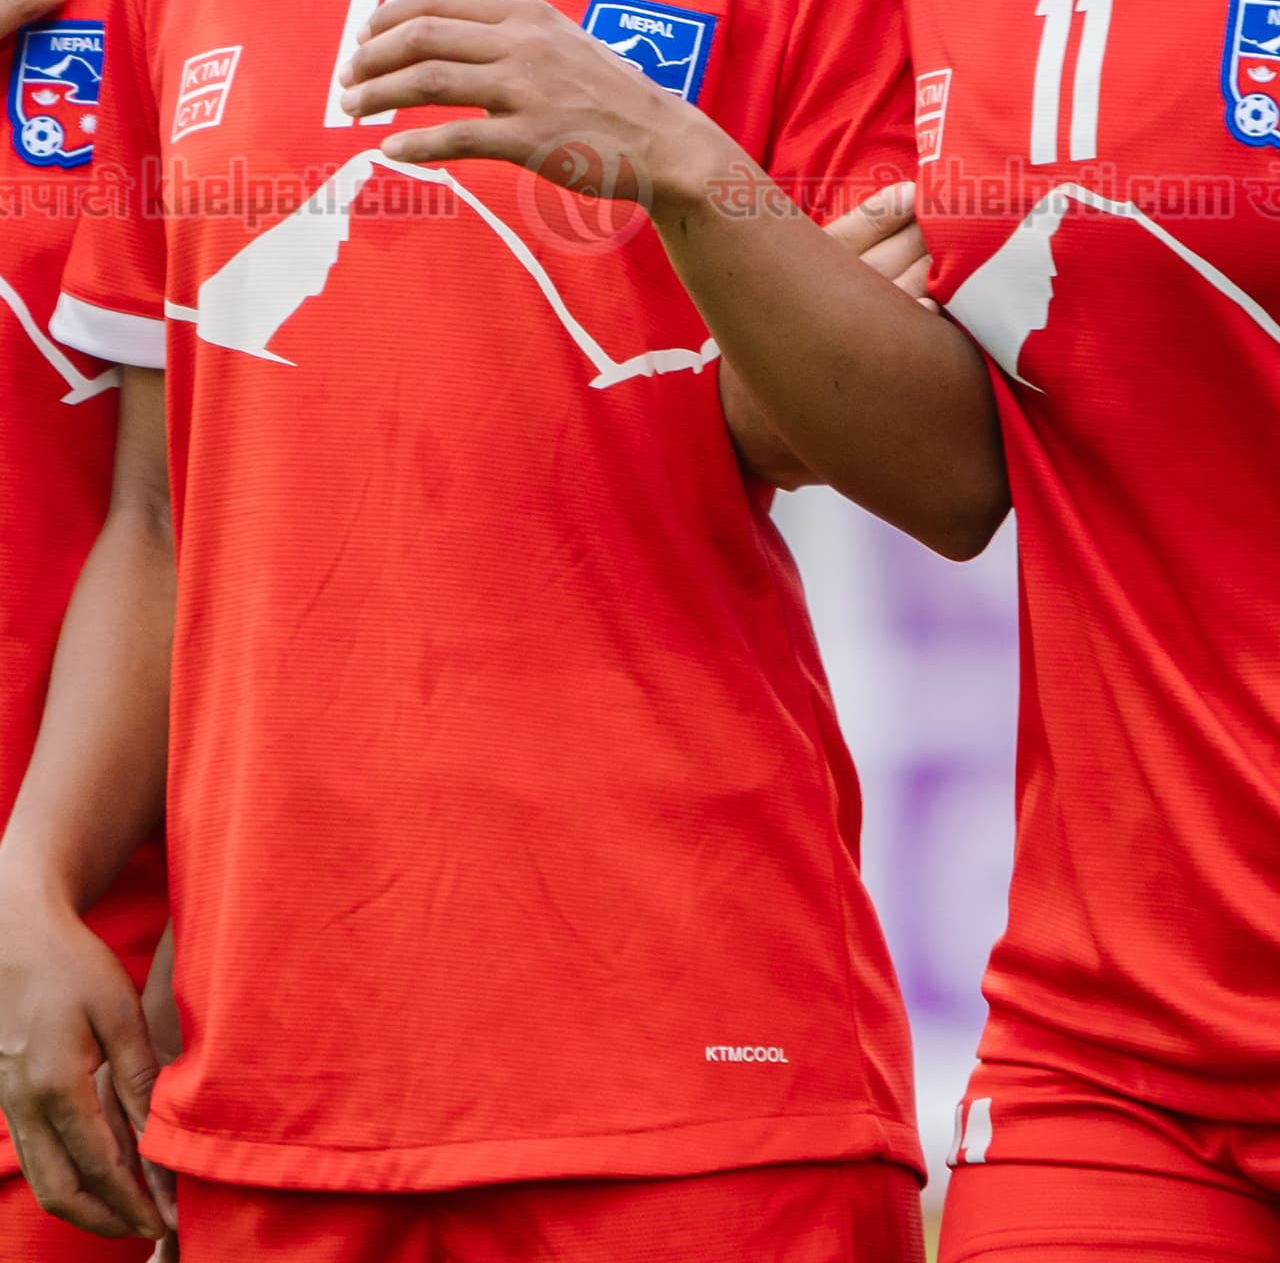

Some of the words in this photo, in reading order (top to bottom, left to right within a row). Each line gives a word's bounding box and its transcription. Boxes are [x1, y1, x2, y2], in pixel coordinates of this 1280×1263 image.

[619, 12, 674, 39] NEPAL
[50, 36, 103, 52] NEPAL
[186, 57, 231, 88] KTM
[178, 96, 218, 127] CTY
[705, 1046, 789, 1063] KTMCOOL
